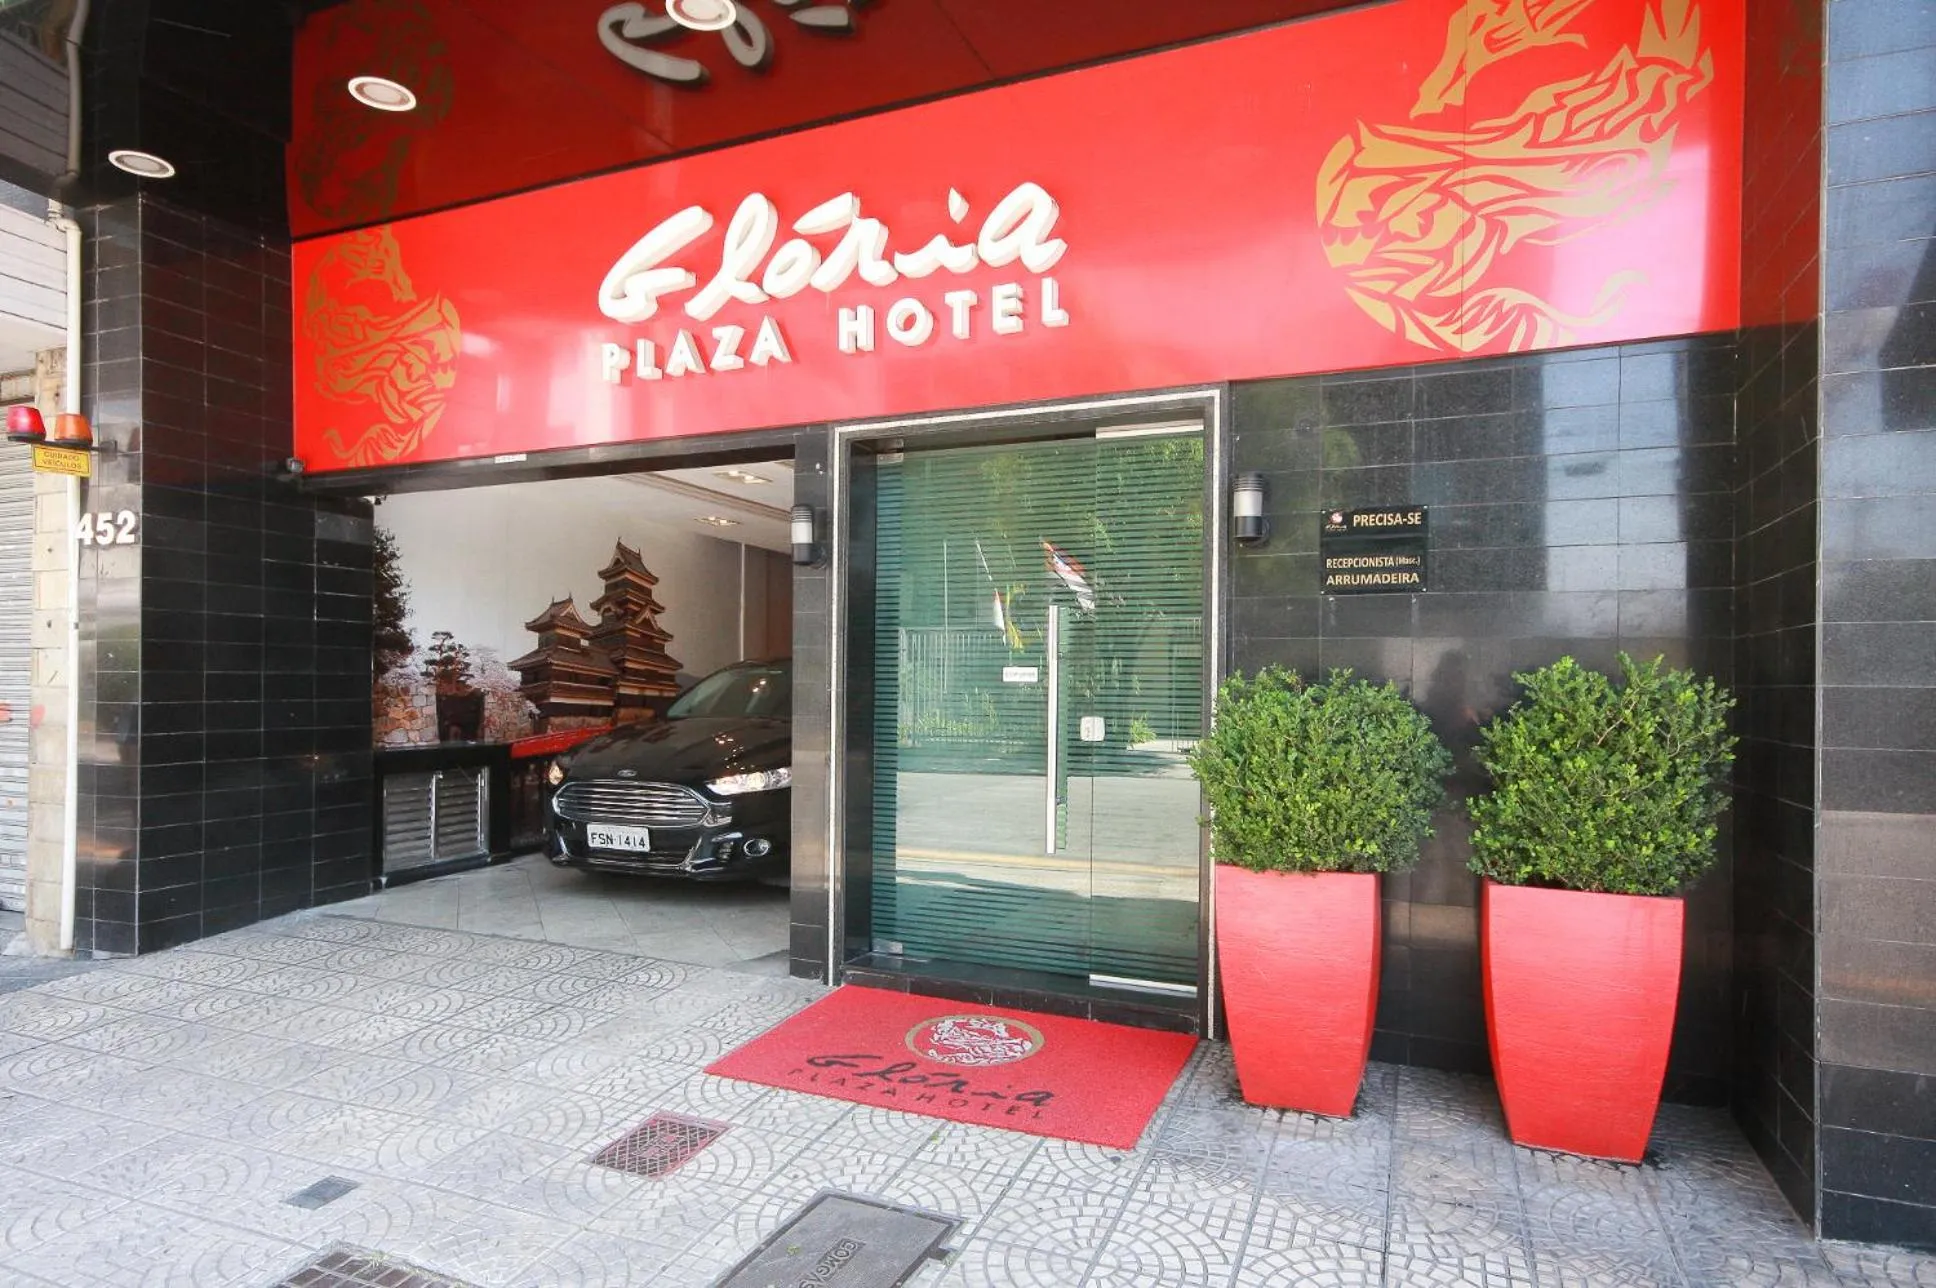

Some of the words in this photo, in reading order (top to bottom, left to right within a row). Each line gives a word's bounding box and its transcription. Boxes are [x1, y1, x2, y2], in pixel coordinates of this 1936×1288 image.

[601, 314, 792, 385] PLAZA
[838, 277, 1069, 354] HOTEL
[75, 509, 136, 545] 452
[1353, 512, 1422, 527] PRECISA-SE
[1326, 556, 1394, 569] RECEPCIONISTA
[1326, 572, 1420, 585] ARRUMADEIRA
[915, 1092, 1044, 1119] HOTEL
